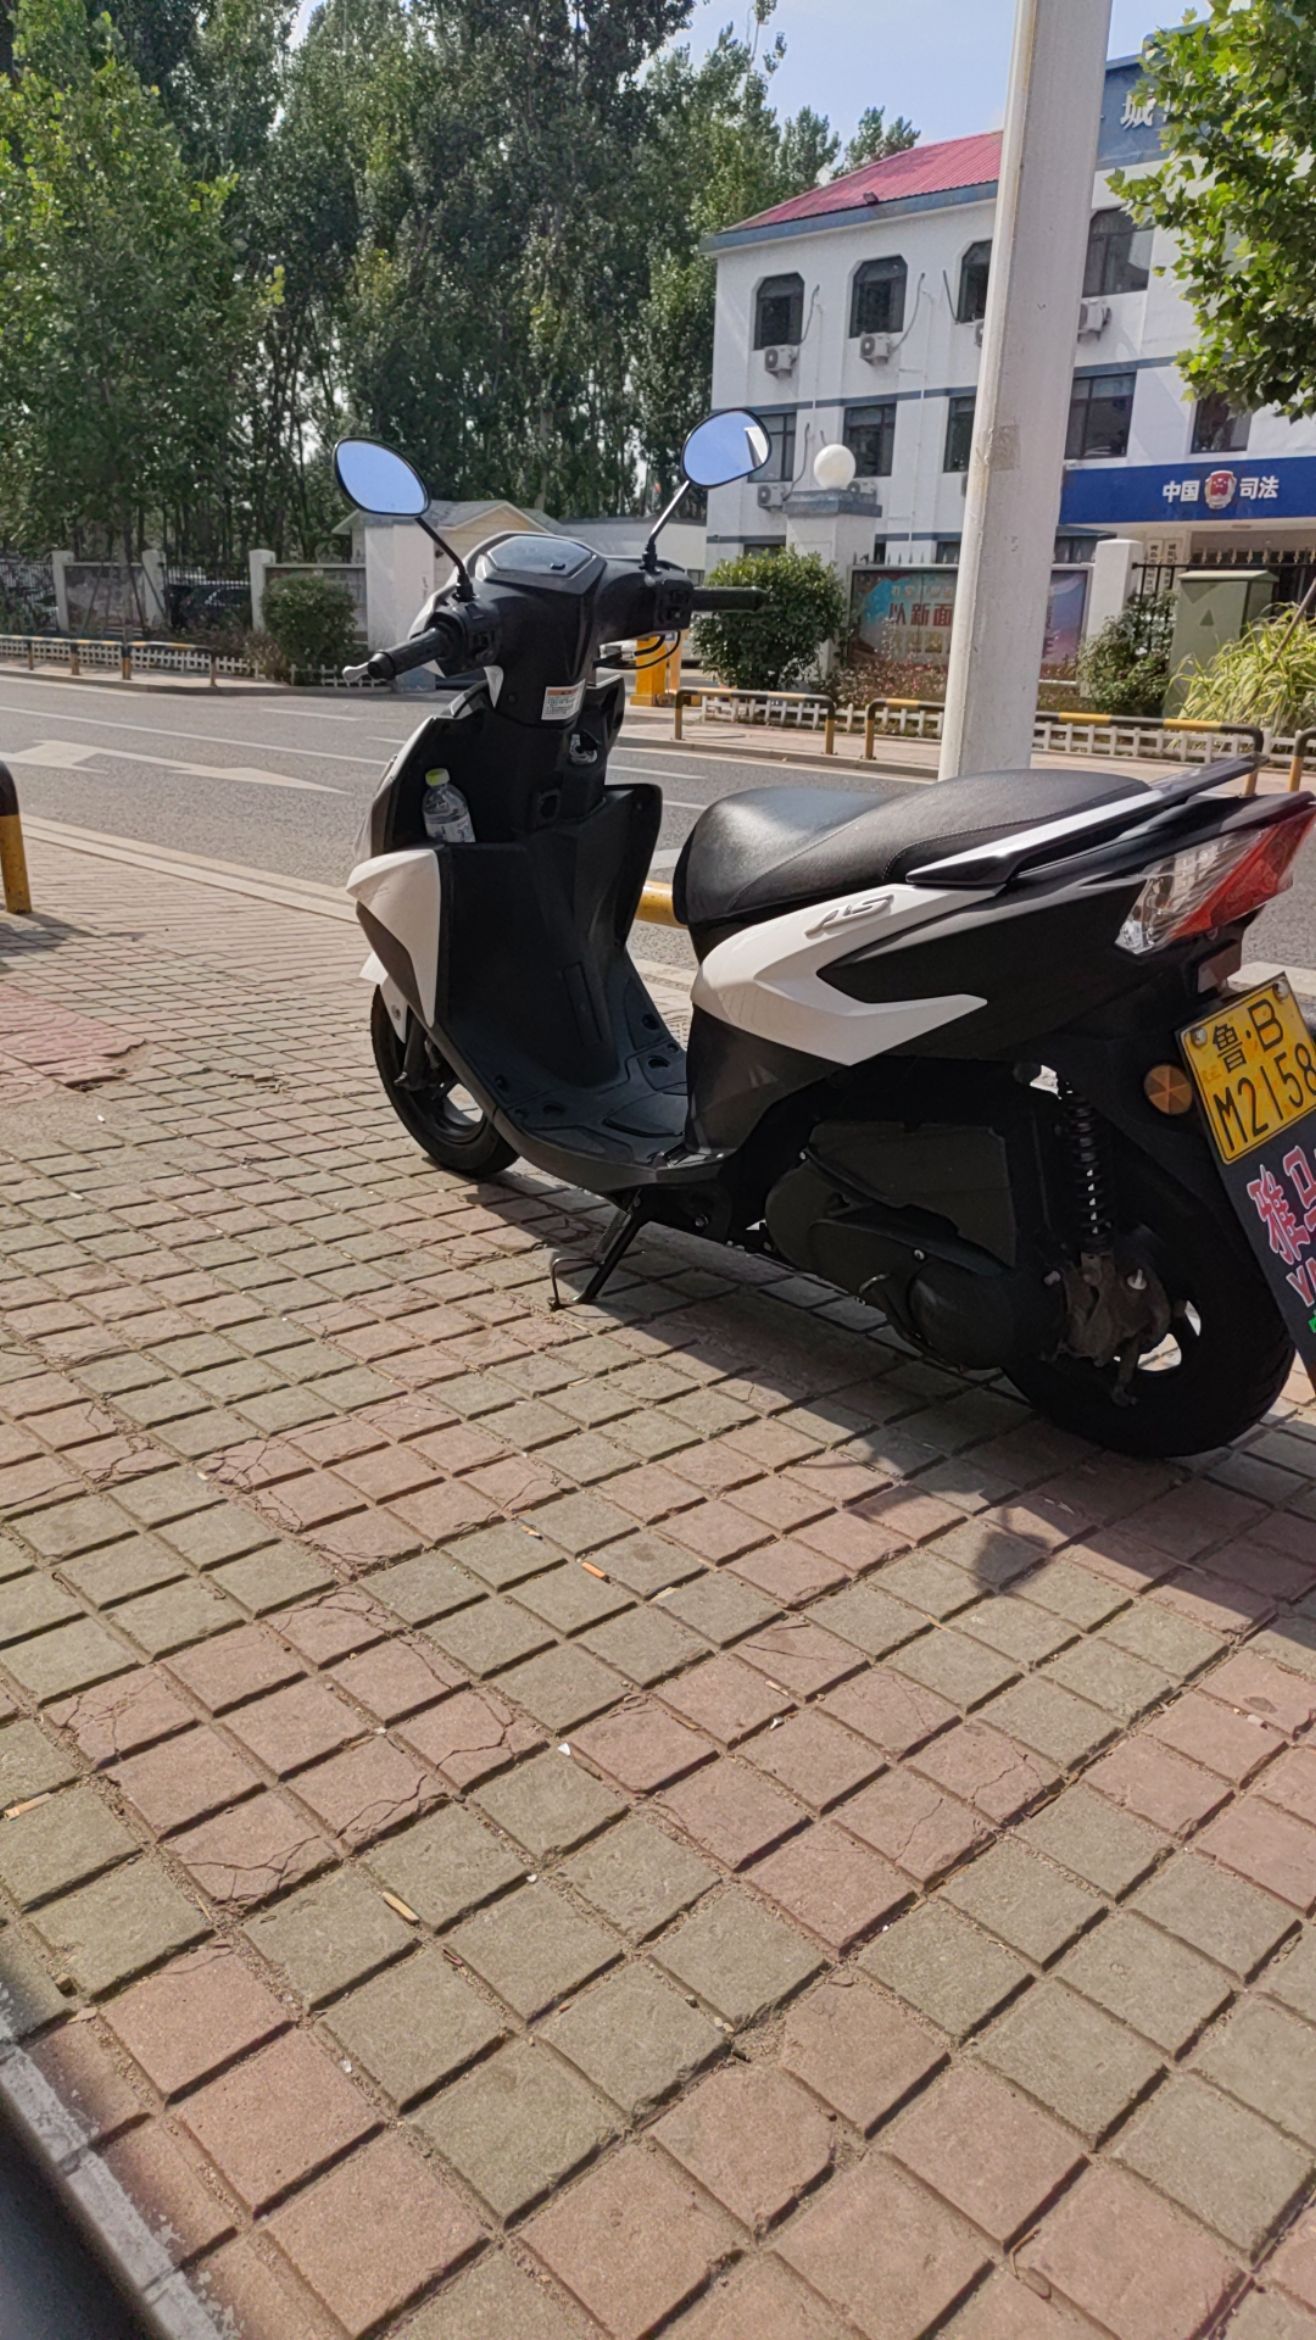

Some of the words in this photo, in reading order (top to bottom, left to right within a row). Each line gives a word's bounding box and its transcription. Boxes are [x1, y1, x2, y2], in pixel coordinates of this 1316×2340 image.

[1162, 480, 1200, 503] 中国
[1239, 475, 1280, 500] 司法
[889, 602, 953, 628] 以新面
[1213, 1042, 1316, 1151] M2158
[1246, 1145, 1316, 1266] 雅马
